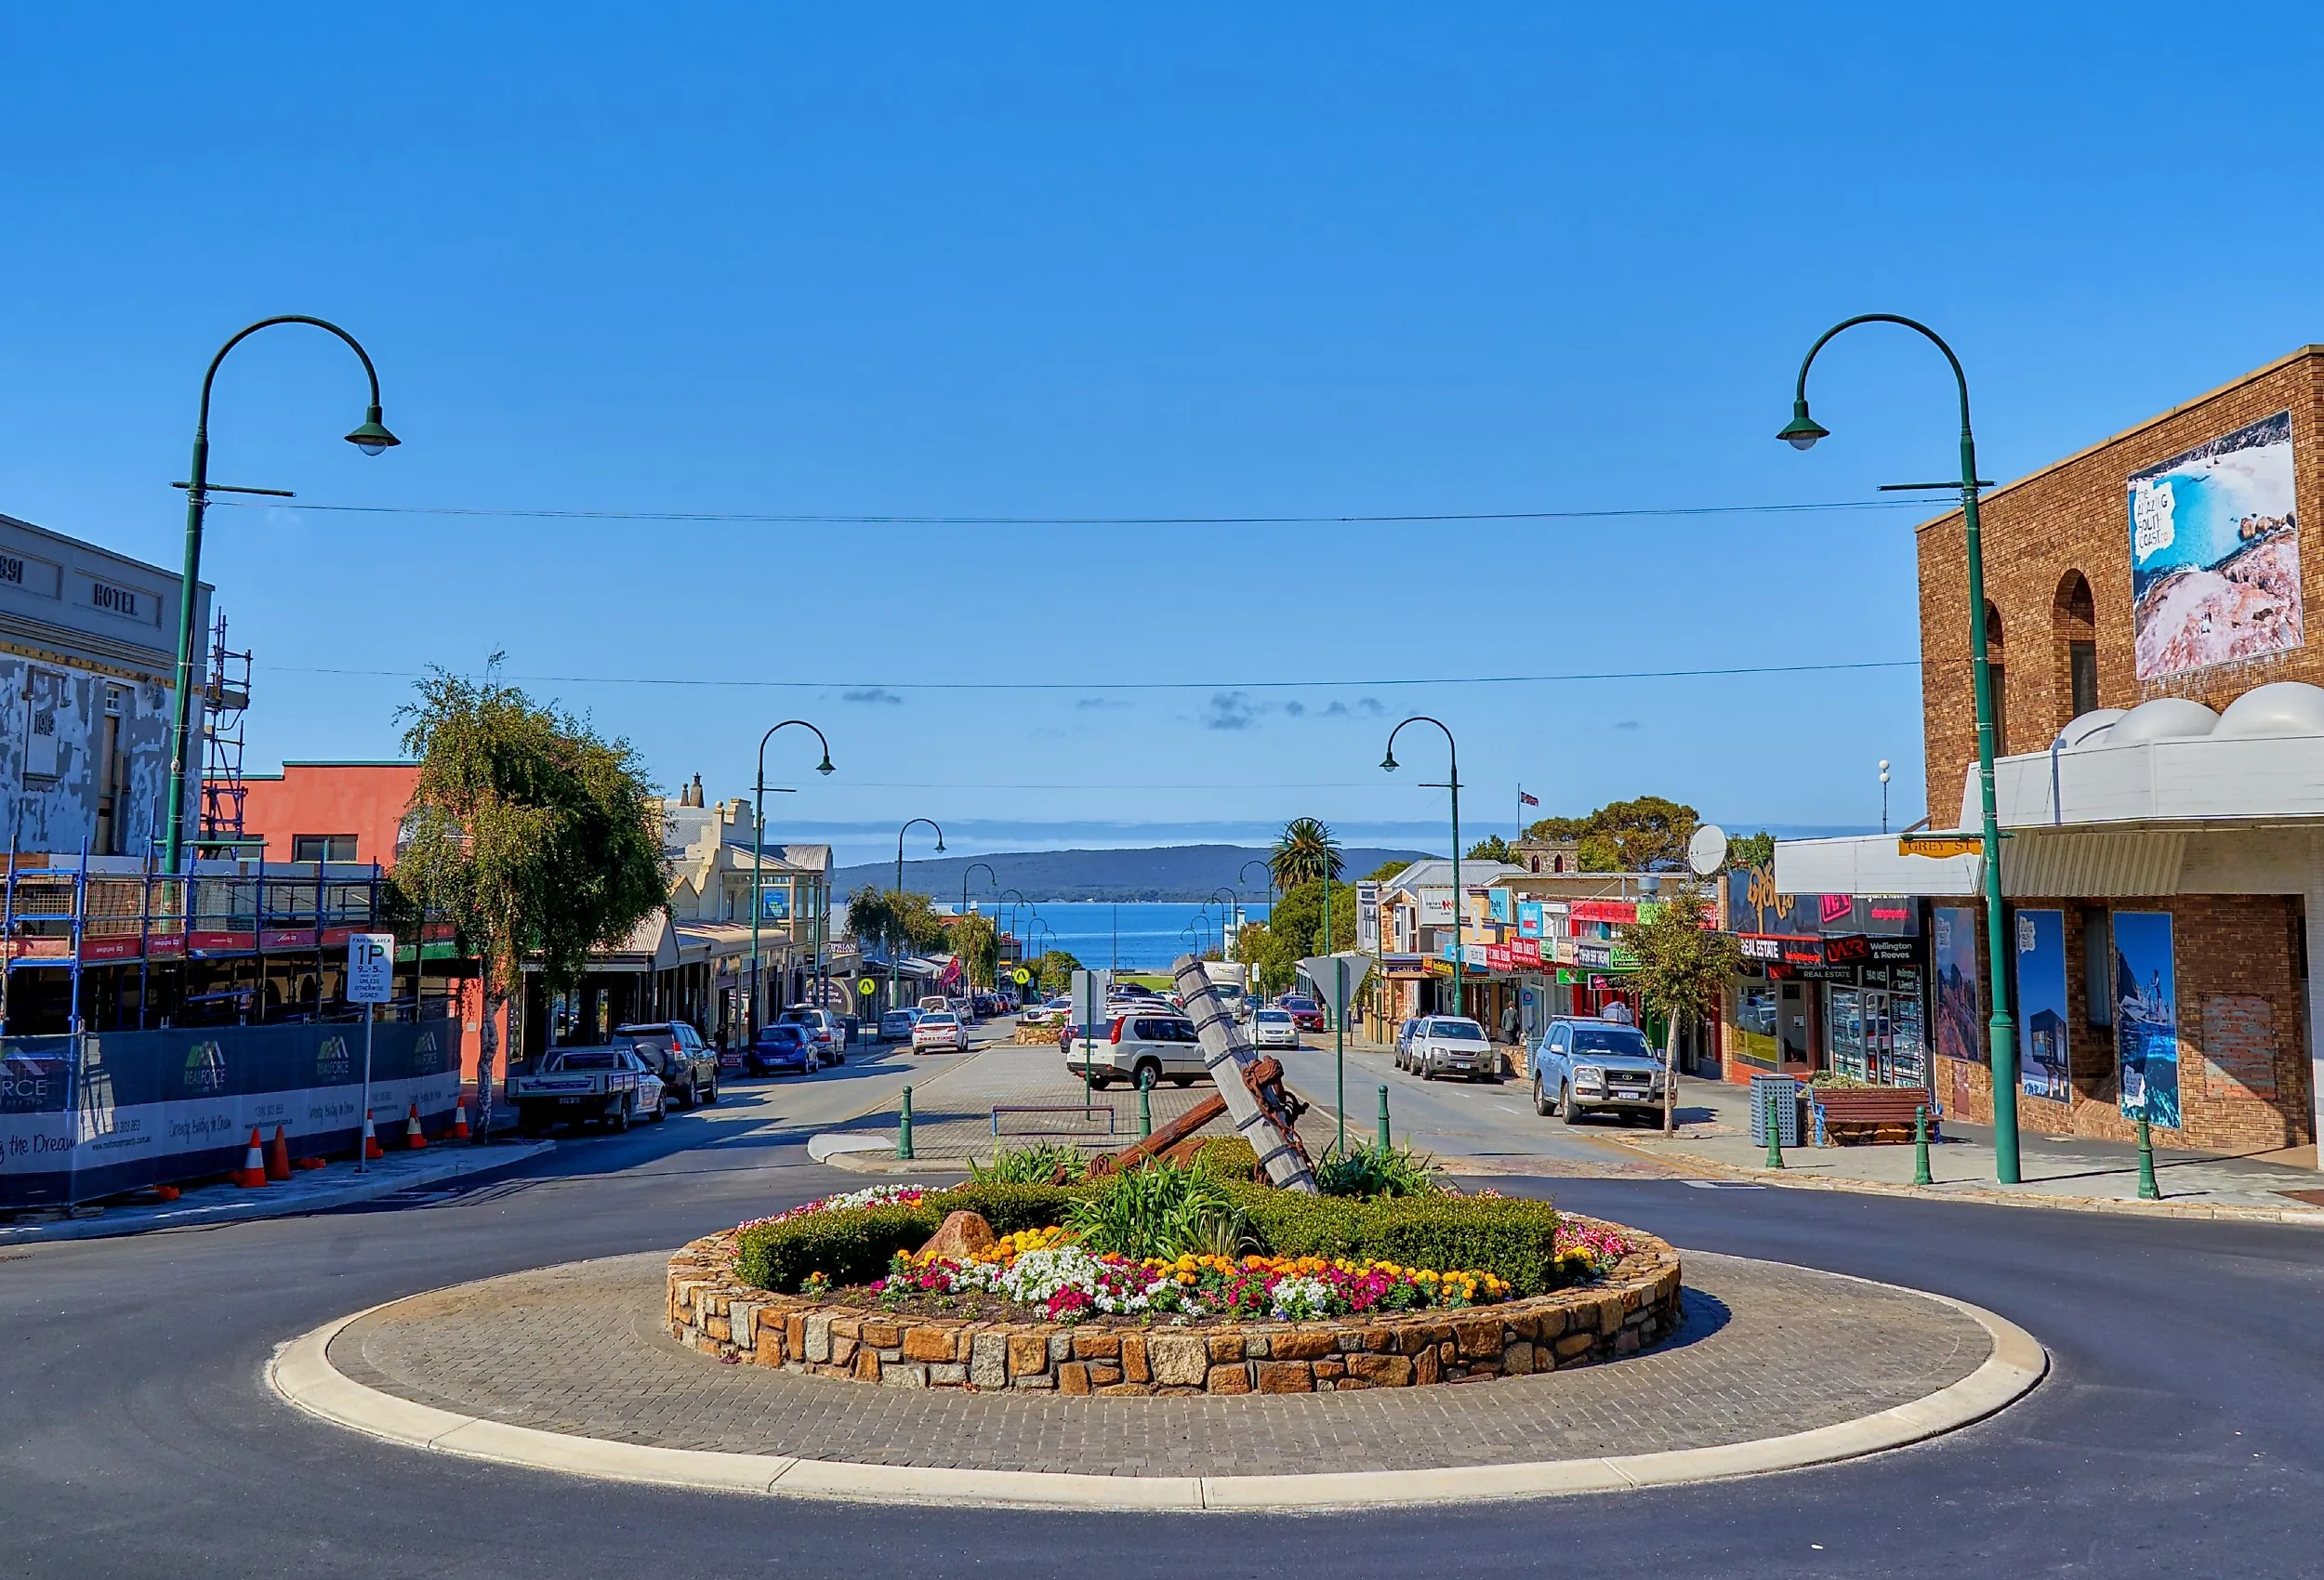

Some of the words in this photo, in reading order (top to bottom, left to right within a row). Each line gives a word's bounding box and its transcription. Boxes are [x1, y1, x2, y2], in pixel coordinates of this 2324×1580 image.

[94, 583, 138, 616] HOTEL
[1908, 841, 1945, 851] GREY
[1954, 841, 1973, 850] ST
[358, 944, 385, 965] 1P
[829, 941, 856, 950] IPRIAN
[1740, 938, 1756, 956] REAL
[1756, 940, 1779, 958] ESTATE
[1869, 941, 1912, 951] Wellington
[9, 1134, 29, 1156] the
[33, 1133, 76, 1153] Dream
